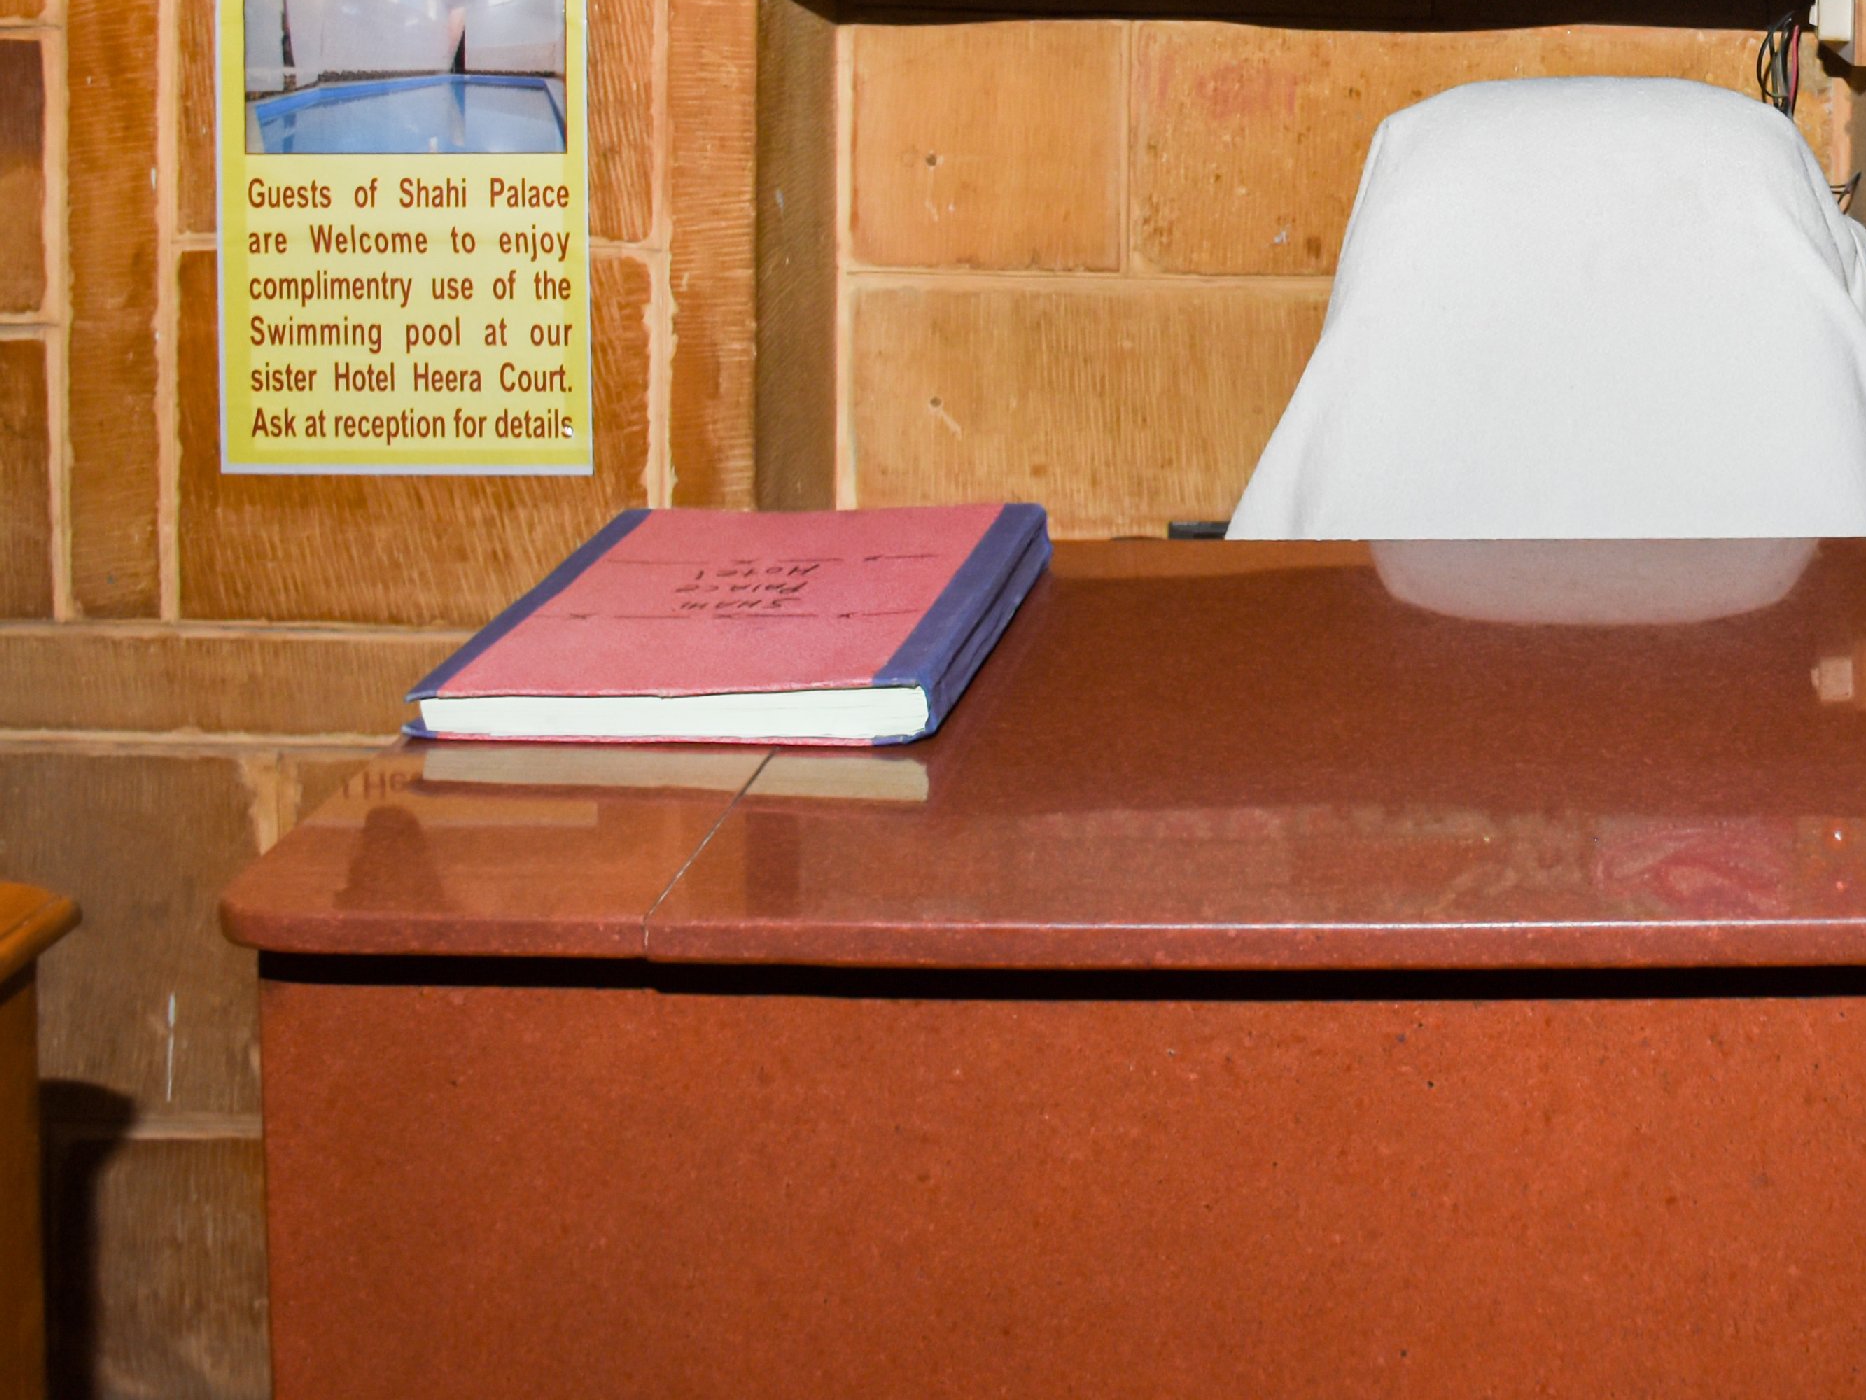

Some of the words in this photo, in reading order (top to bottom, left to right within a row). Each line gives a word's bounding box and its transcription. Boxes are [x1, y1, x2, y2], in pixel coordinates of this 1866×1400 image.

[248, 178, 332, 209] Guests
[353, 178, 378, 208] of
[399, 177, 467, 209] Shahi
[489, 177, 569, 208] Palace
[249, 230, 287, 254] are
[310, 224, 428, 254] Welcome
[451, 227, 475, 254] to
[499, 226, 570, 262] enjoy
[249, 271, 412, 307] complimentry
[431, 276, 473, 300] use
[492, 270, 516, 300] of
[534, 271, 571, 300] the
[250, 316, 382, 353] Swimming
[405, 316, 461, 353] pool
[484, 319, 508, 346] at
[530, 323, 572, 346] our
[250, 363, 317, 393] sister
[333, 363, 396, 393] Hotel
[412, 362, 482, 393] Heera
[499, 362, 573, 393] Court.
[251, 408, 297, 438] Ask
[304, 410, 326, 438] at
[334, 409, 446, 445] reception
[452, 408, 488, 438] for
[494, 408, 573, 438] details
